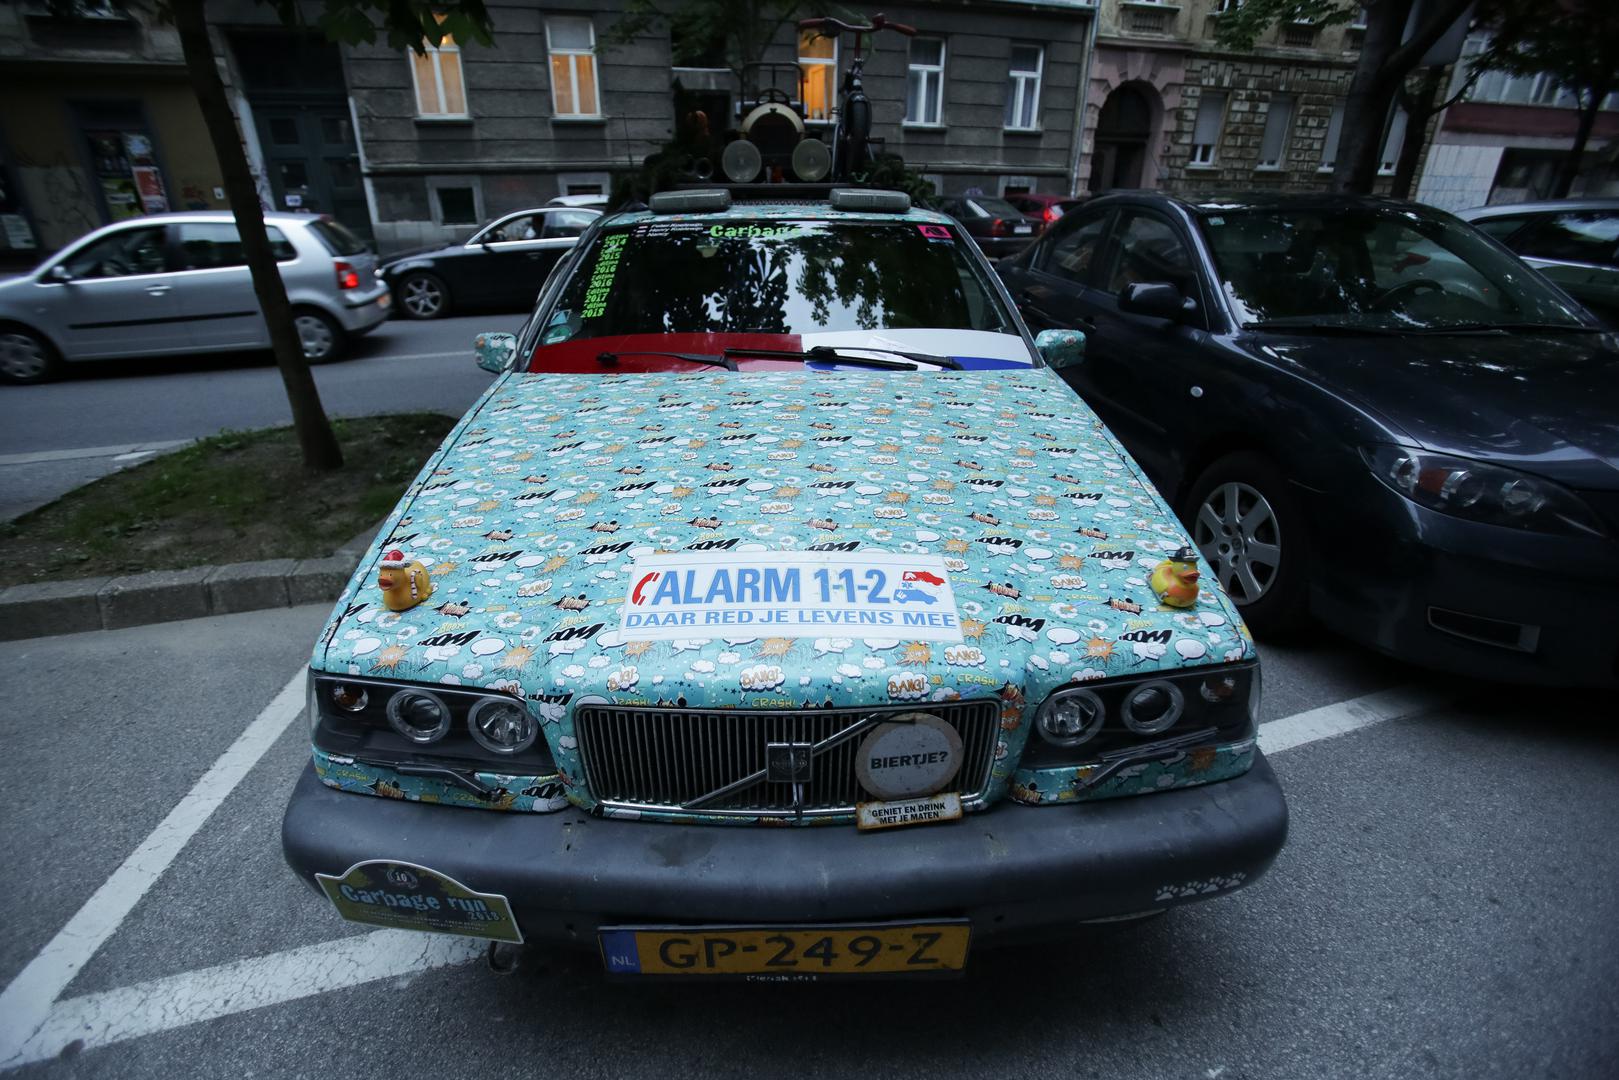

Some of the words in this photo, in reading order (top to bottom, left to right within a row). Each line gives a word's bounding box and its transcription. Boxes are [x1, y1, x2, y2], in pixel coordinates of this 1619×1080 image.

[651, 567, 801, 606] ALARM
[814, 568, 890, 605] 1-1-2
[626, 612, 696, 628] DAAR
[705, 610, 755, 624] RED
[759, 610, 789, 624] JE
[799, 610, 894, 625] LEVENS
[903, 612, 957, 628] MEE
[889, 677, 925, 694] BANG!
[870, 751, 949, 770] BIERTJE?
[871, 807, 902, 818] GENIET
[904, 805, 916, 813] EN
[918, 802, 946, 812] DRINK
[880, 815, 899, 825] MET
[899, 814, 909, 822] JE
[911, 811, 940, 821] MATEN
[395, 872, 408, 882] 10
[339, 884, 441, 911] Carbage
[447, 897, 488, 912] run
[468, 911, 500, 921] 2018
[659, 933, 943, 969] GP-249-Z
[612, 955, 636, 967] NL
